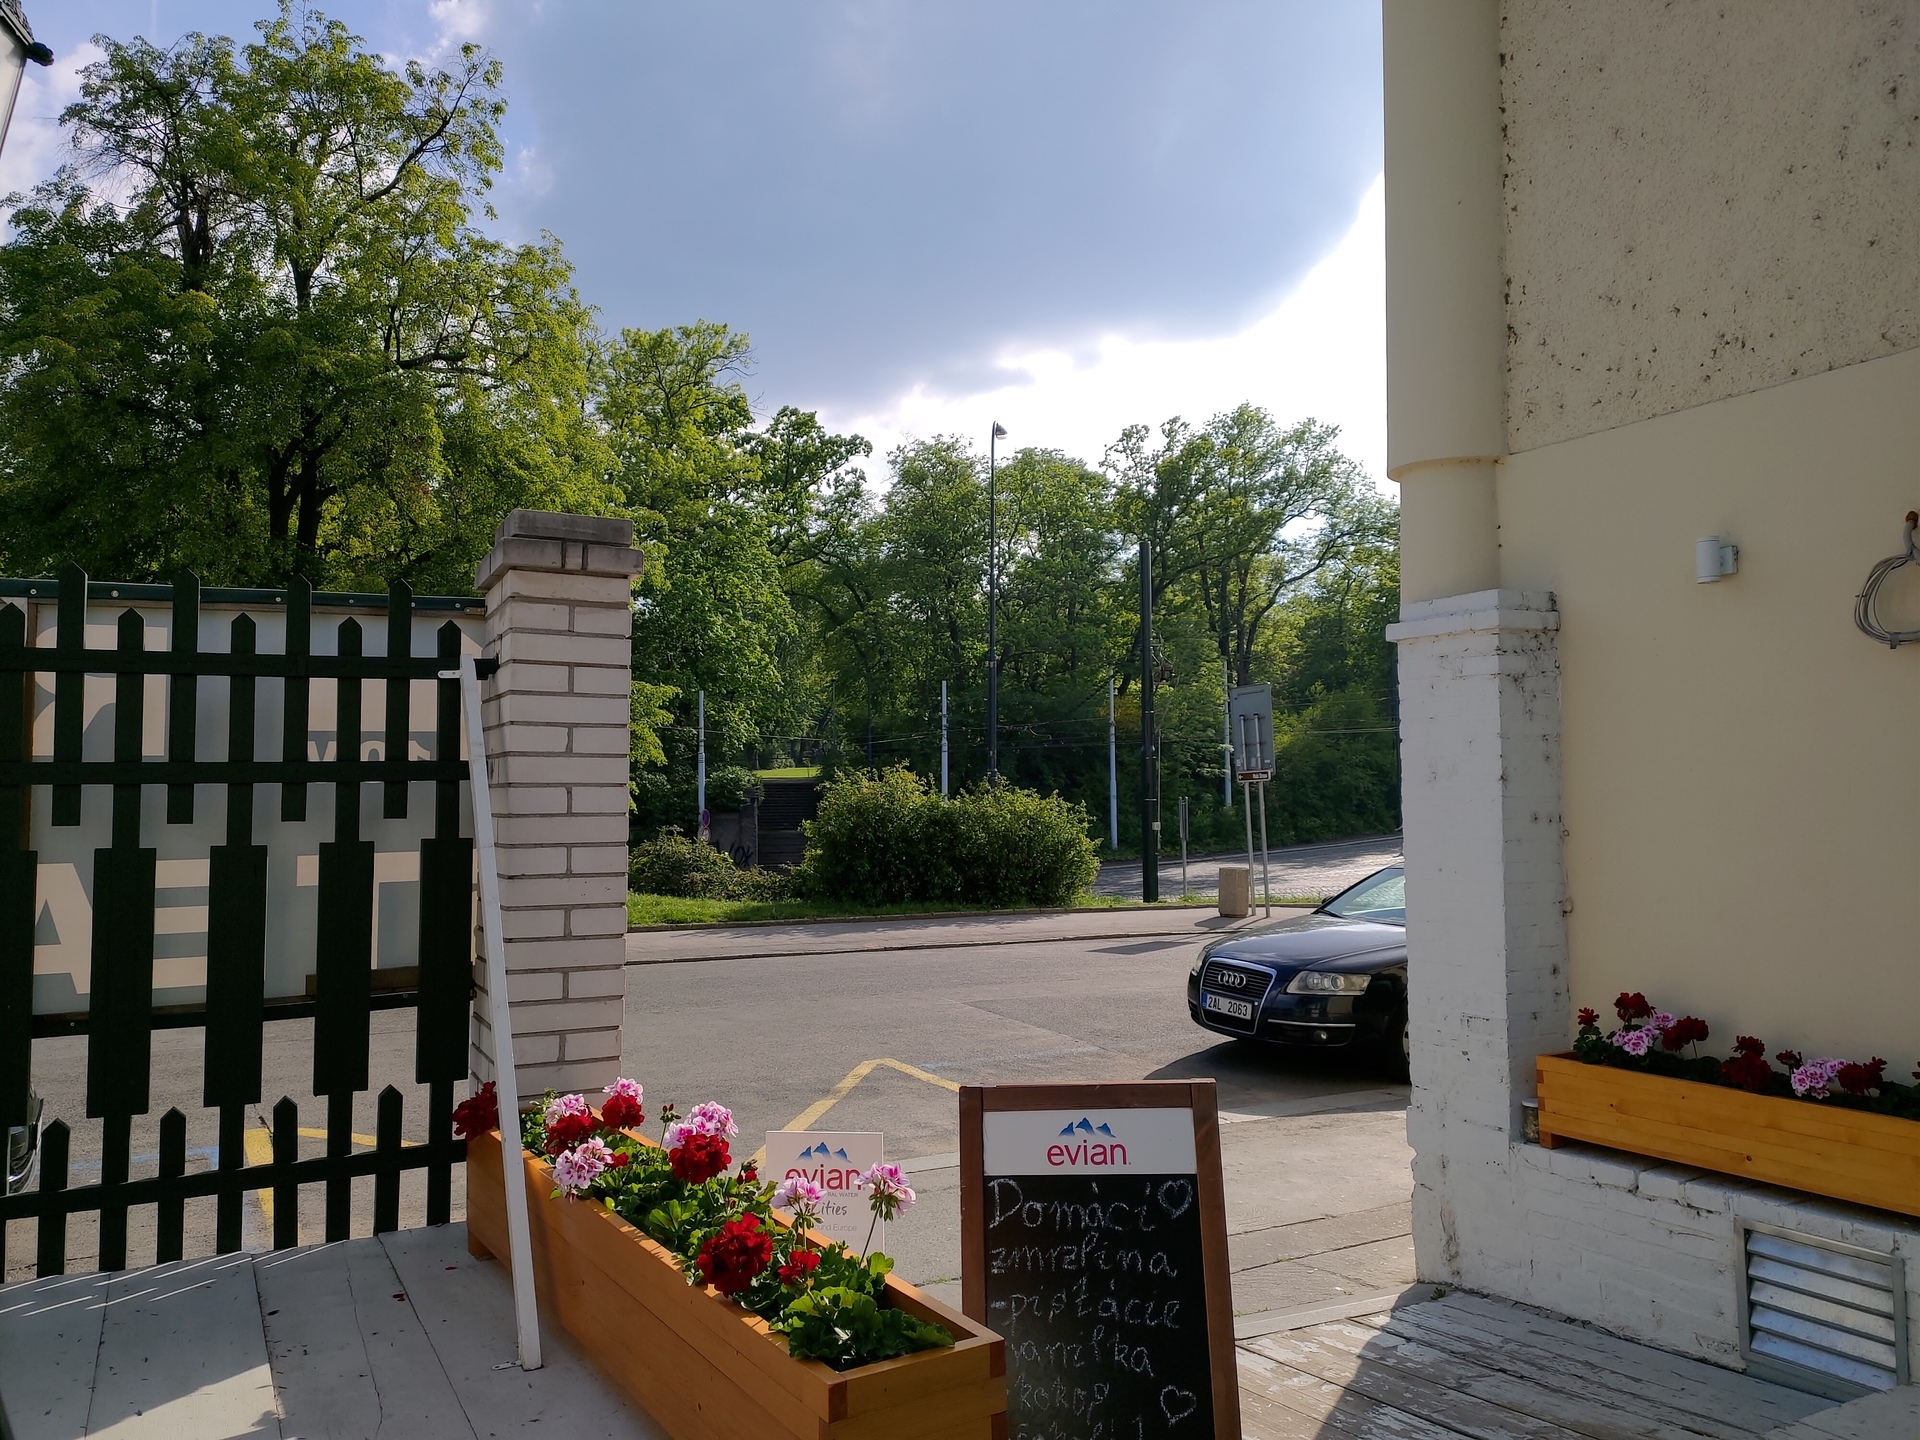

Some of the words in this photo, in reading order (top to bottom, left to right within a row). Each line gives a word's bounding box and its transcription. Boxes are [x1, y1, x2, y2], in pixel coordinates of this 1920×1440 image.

[1208, 997, 1221, 1010] 2AL
[1228, 1001, 1247, 1016] 2063
[1047, 1139, 1127, 1166] evian
[833, 1224, 857, 1232] Europe
[990, 1231, 1178, 1278] zmrzlina
